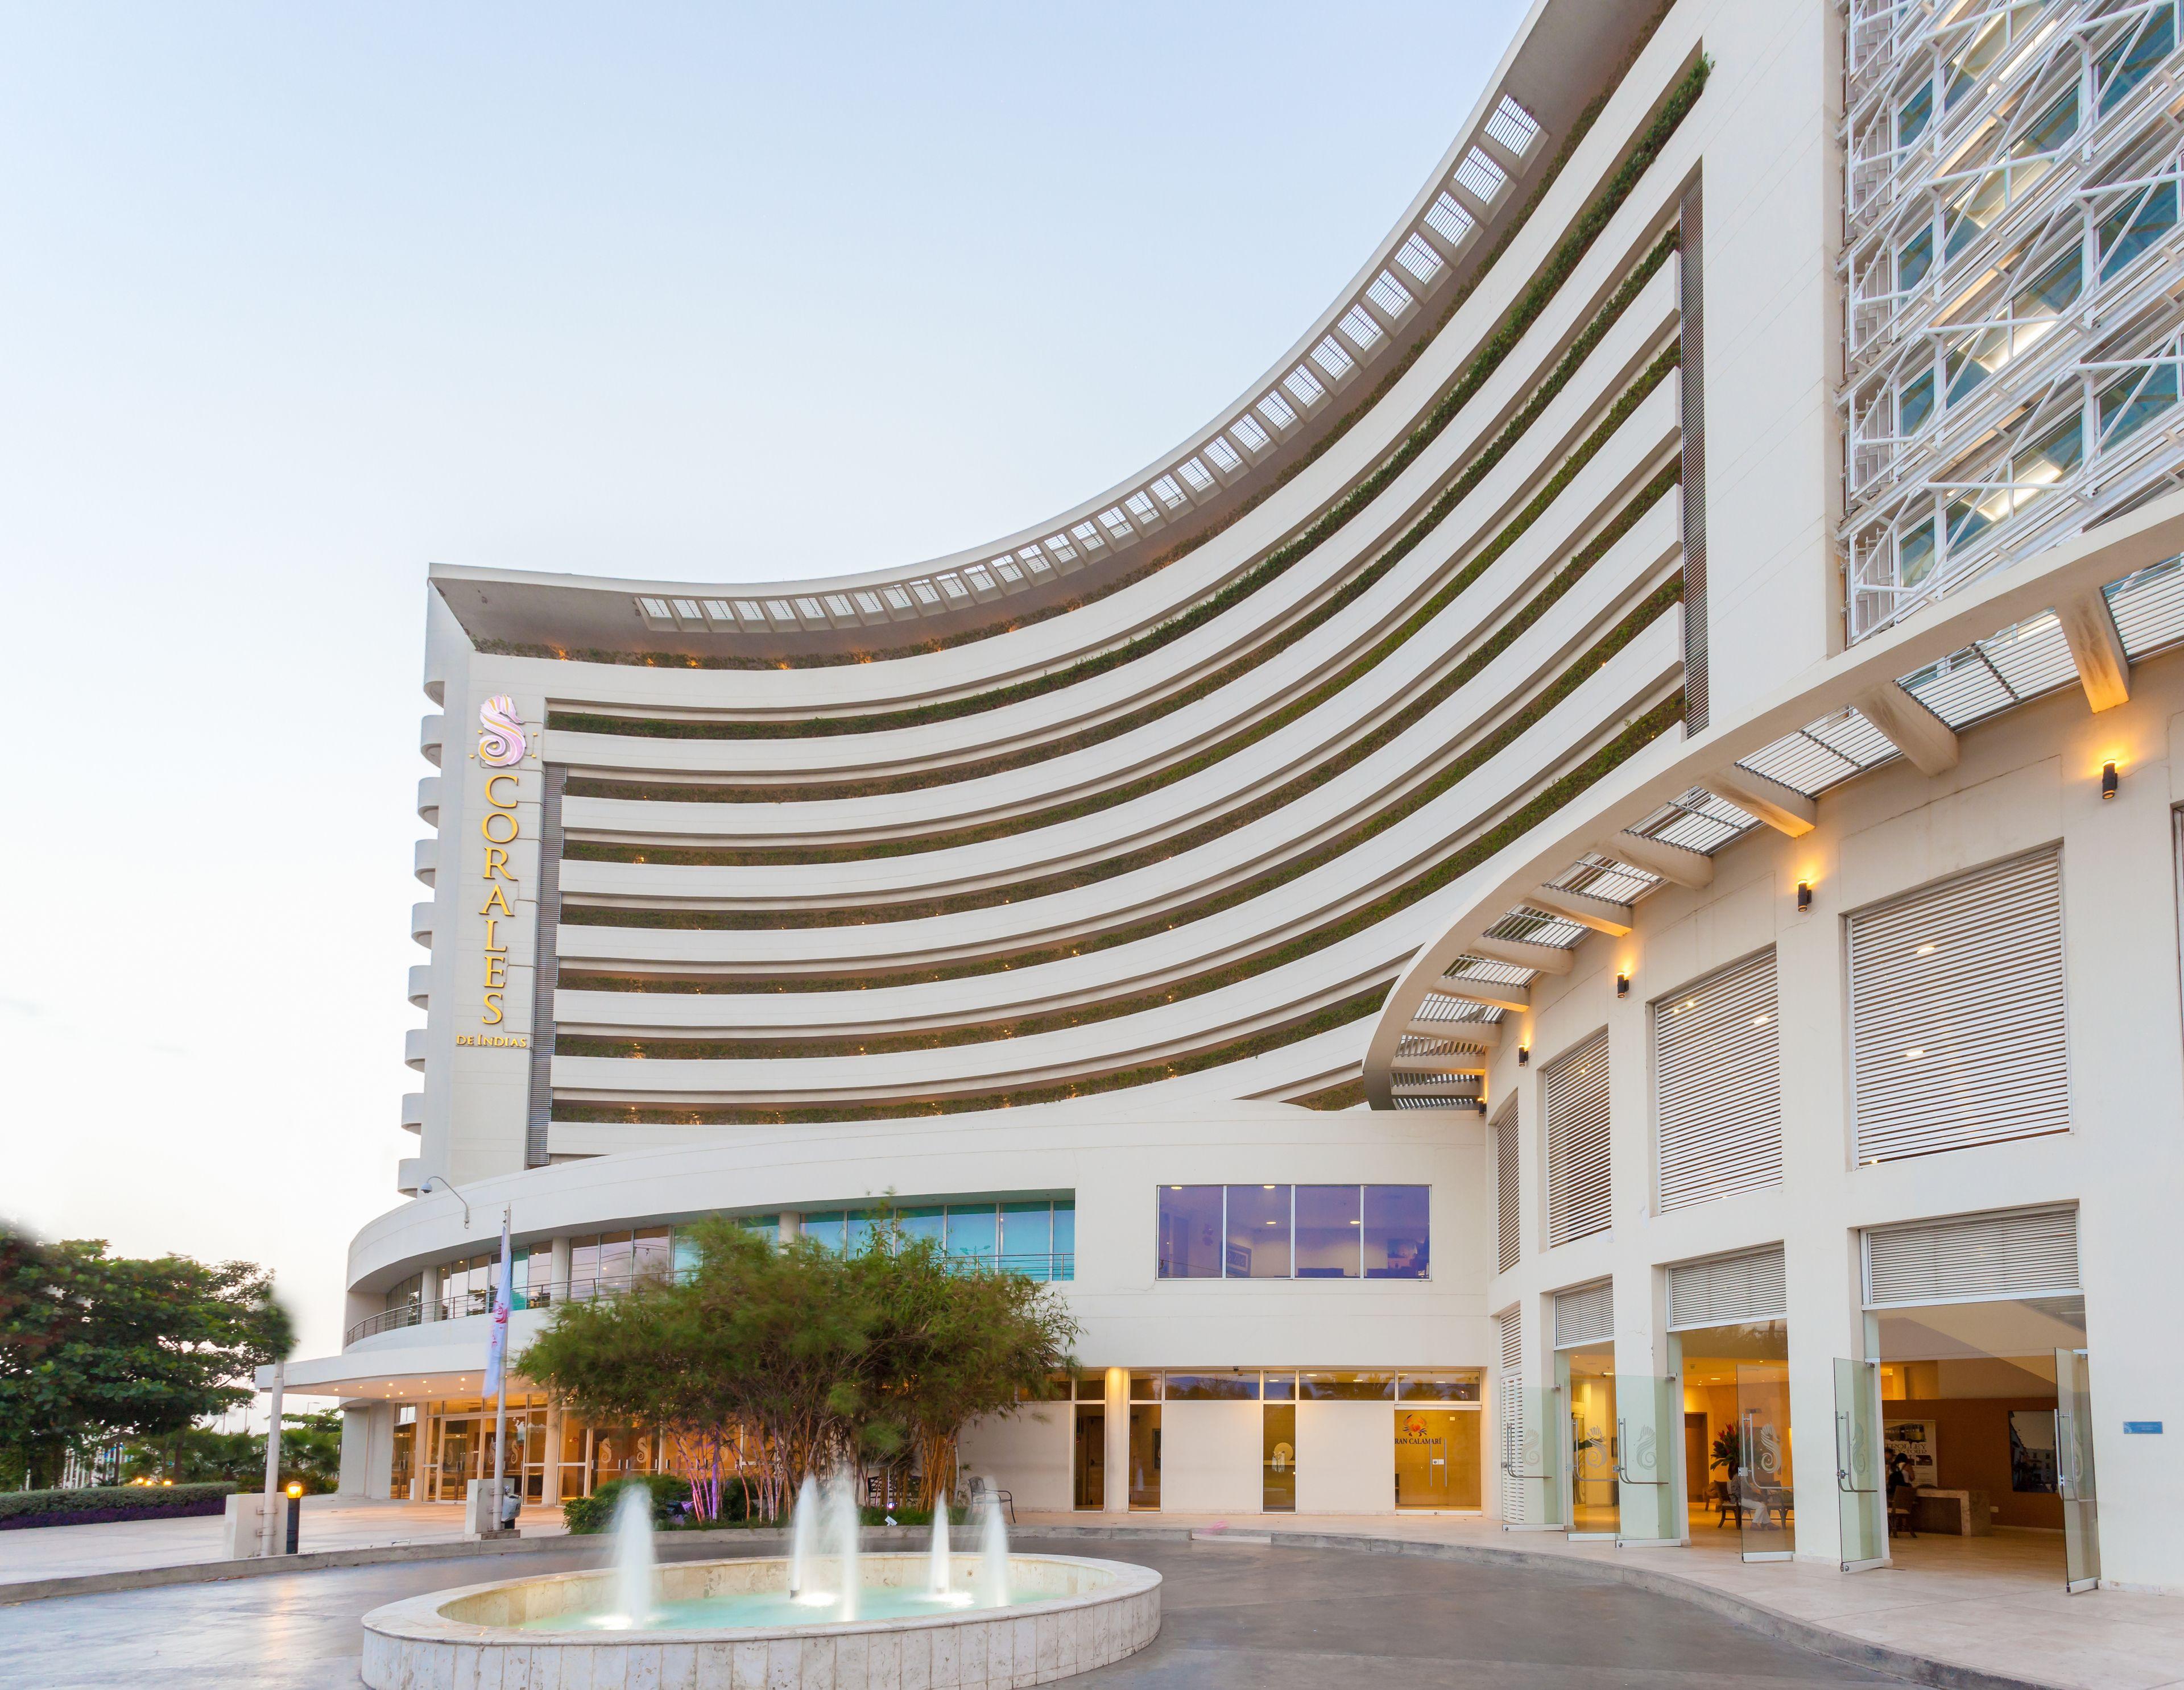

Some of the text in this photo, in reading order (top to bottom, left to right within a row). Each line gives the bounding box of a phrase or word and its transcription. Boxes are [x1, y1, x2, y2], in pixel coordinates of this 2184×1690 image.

[479, 774, 519, 1025] CORALES
[456, 1033, 527, 1048] DE INDIAS
